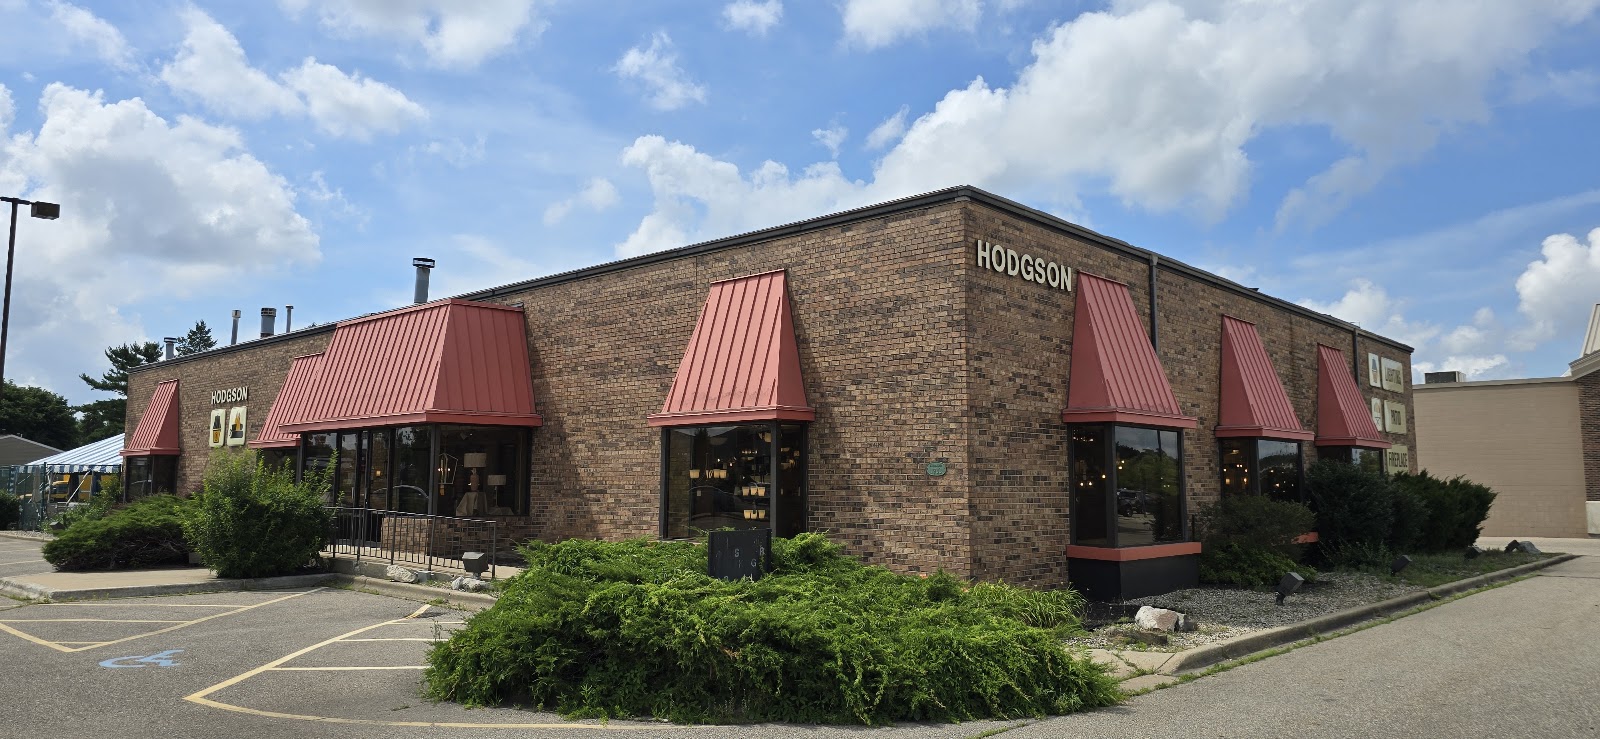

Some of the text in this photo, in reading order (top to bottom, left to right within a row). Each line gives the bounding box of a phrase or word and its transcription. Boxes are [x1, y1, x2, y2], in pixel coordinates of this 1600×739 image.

[977, 240, 1072, 292] HODGSON
[211, 386, 248, 404] HODGSON
[1388, 452, 1408, 468] FIREPLACE
